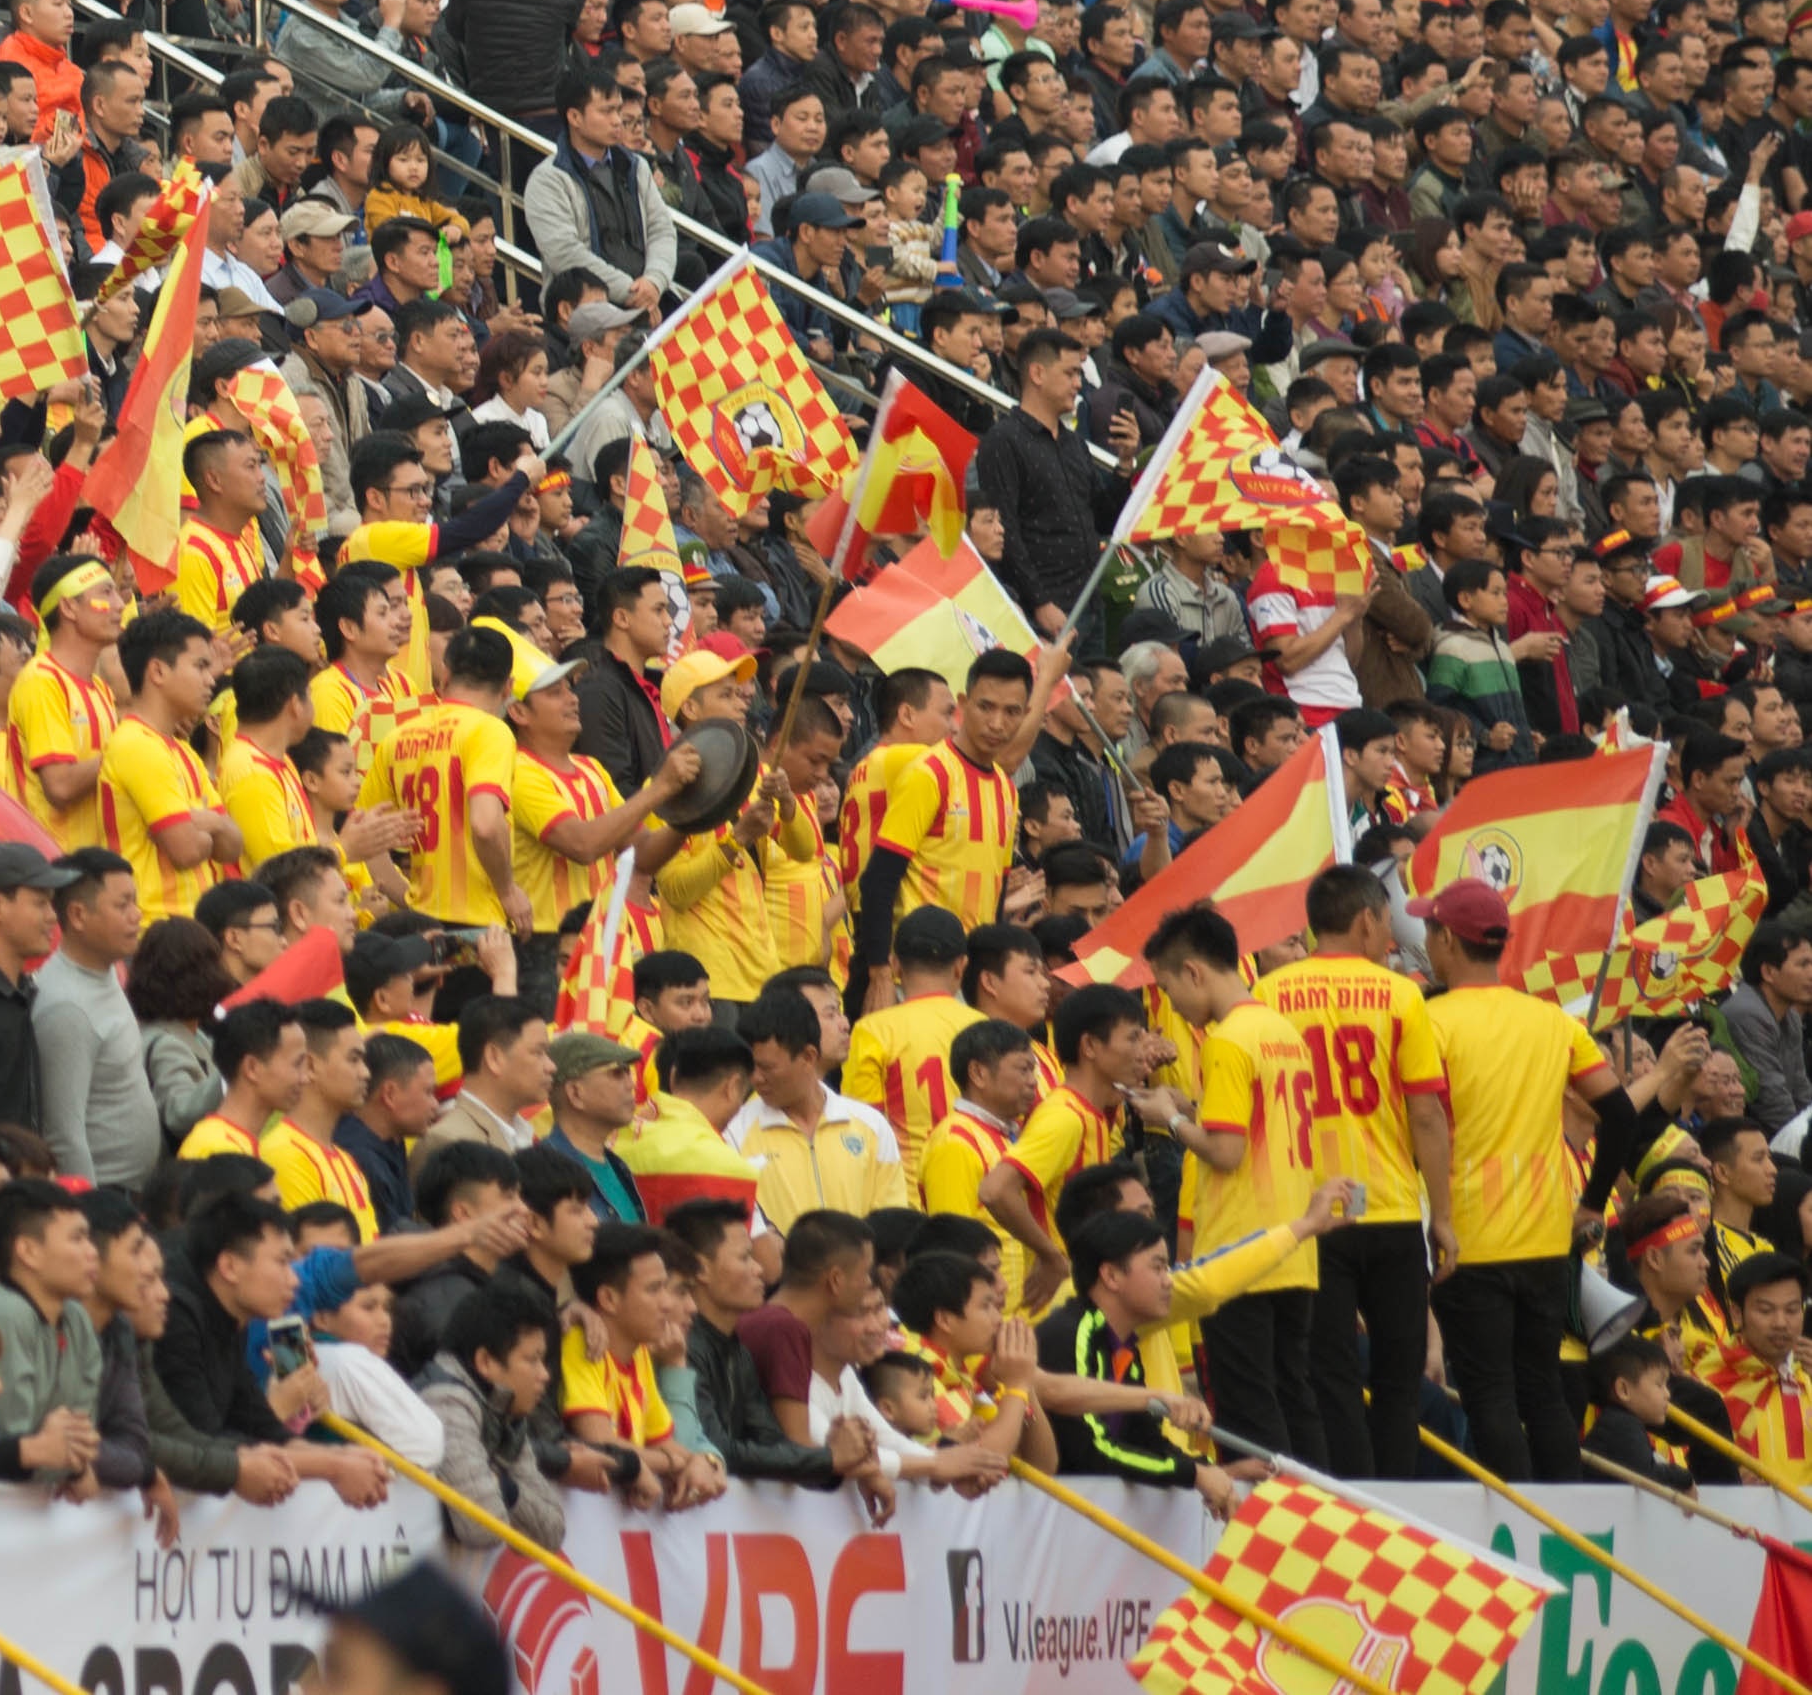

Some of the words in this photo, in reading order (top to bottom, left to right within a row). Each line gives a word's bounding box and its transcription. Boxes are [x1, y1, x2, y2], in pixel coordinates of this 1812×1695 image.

[1278, 986, 1329, 1015] NAM
[1337, 986, 1392, 1016] ĐỊNH
[1303, 1023, 1381, 1118] 18
[208, 1548, 255, 1638] TỤ
[1001, 1599, 1152, 1679] V.league.VPF
